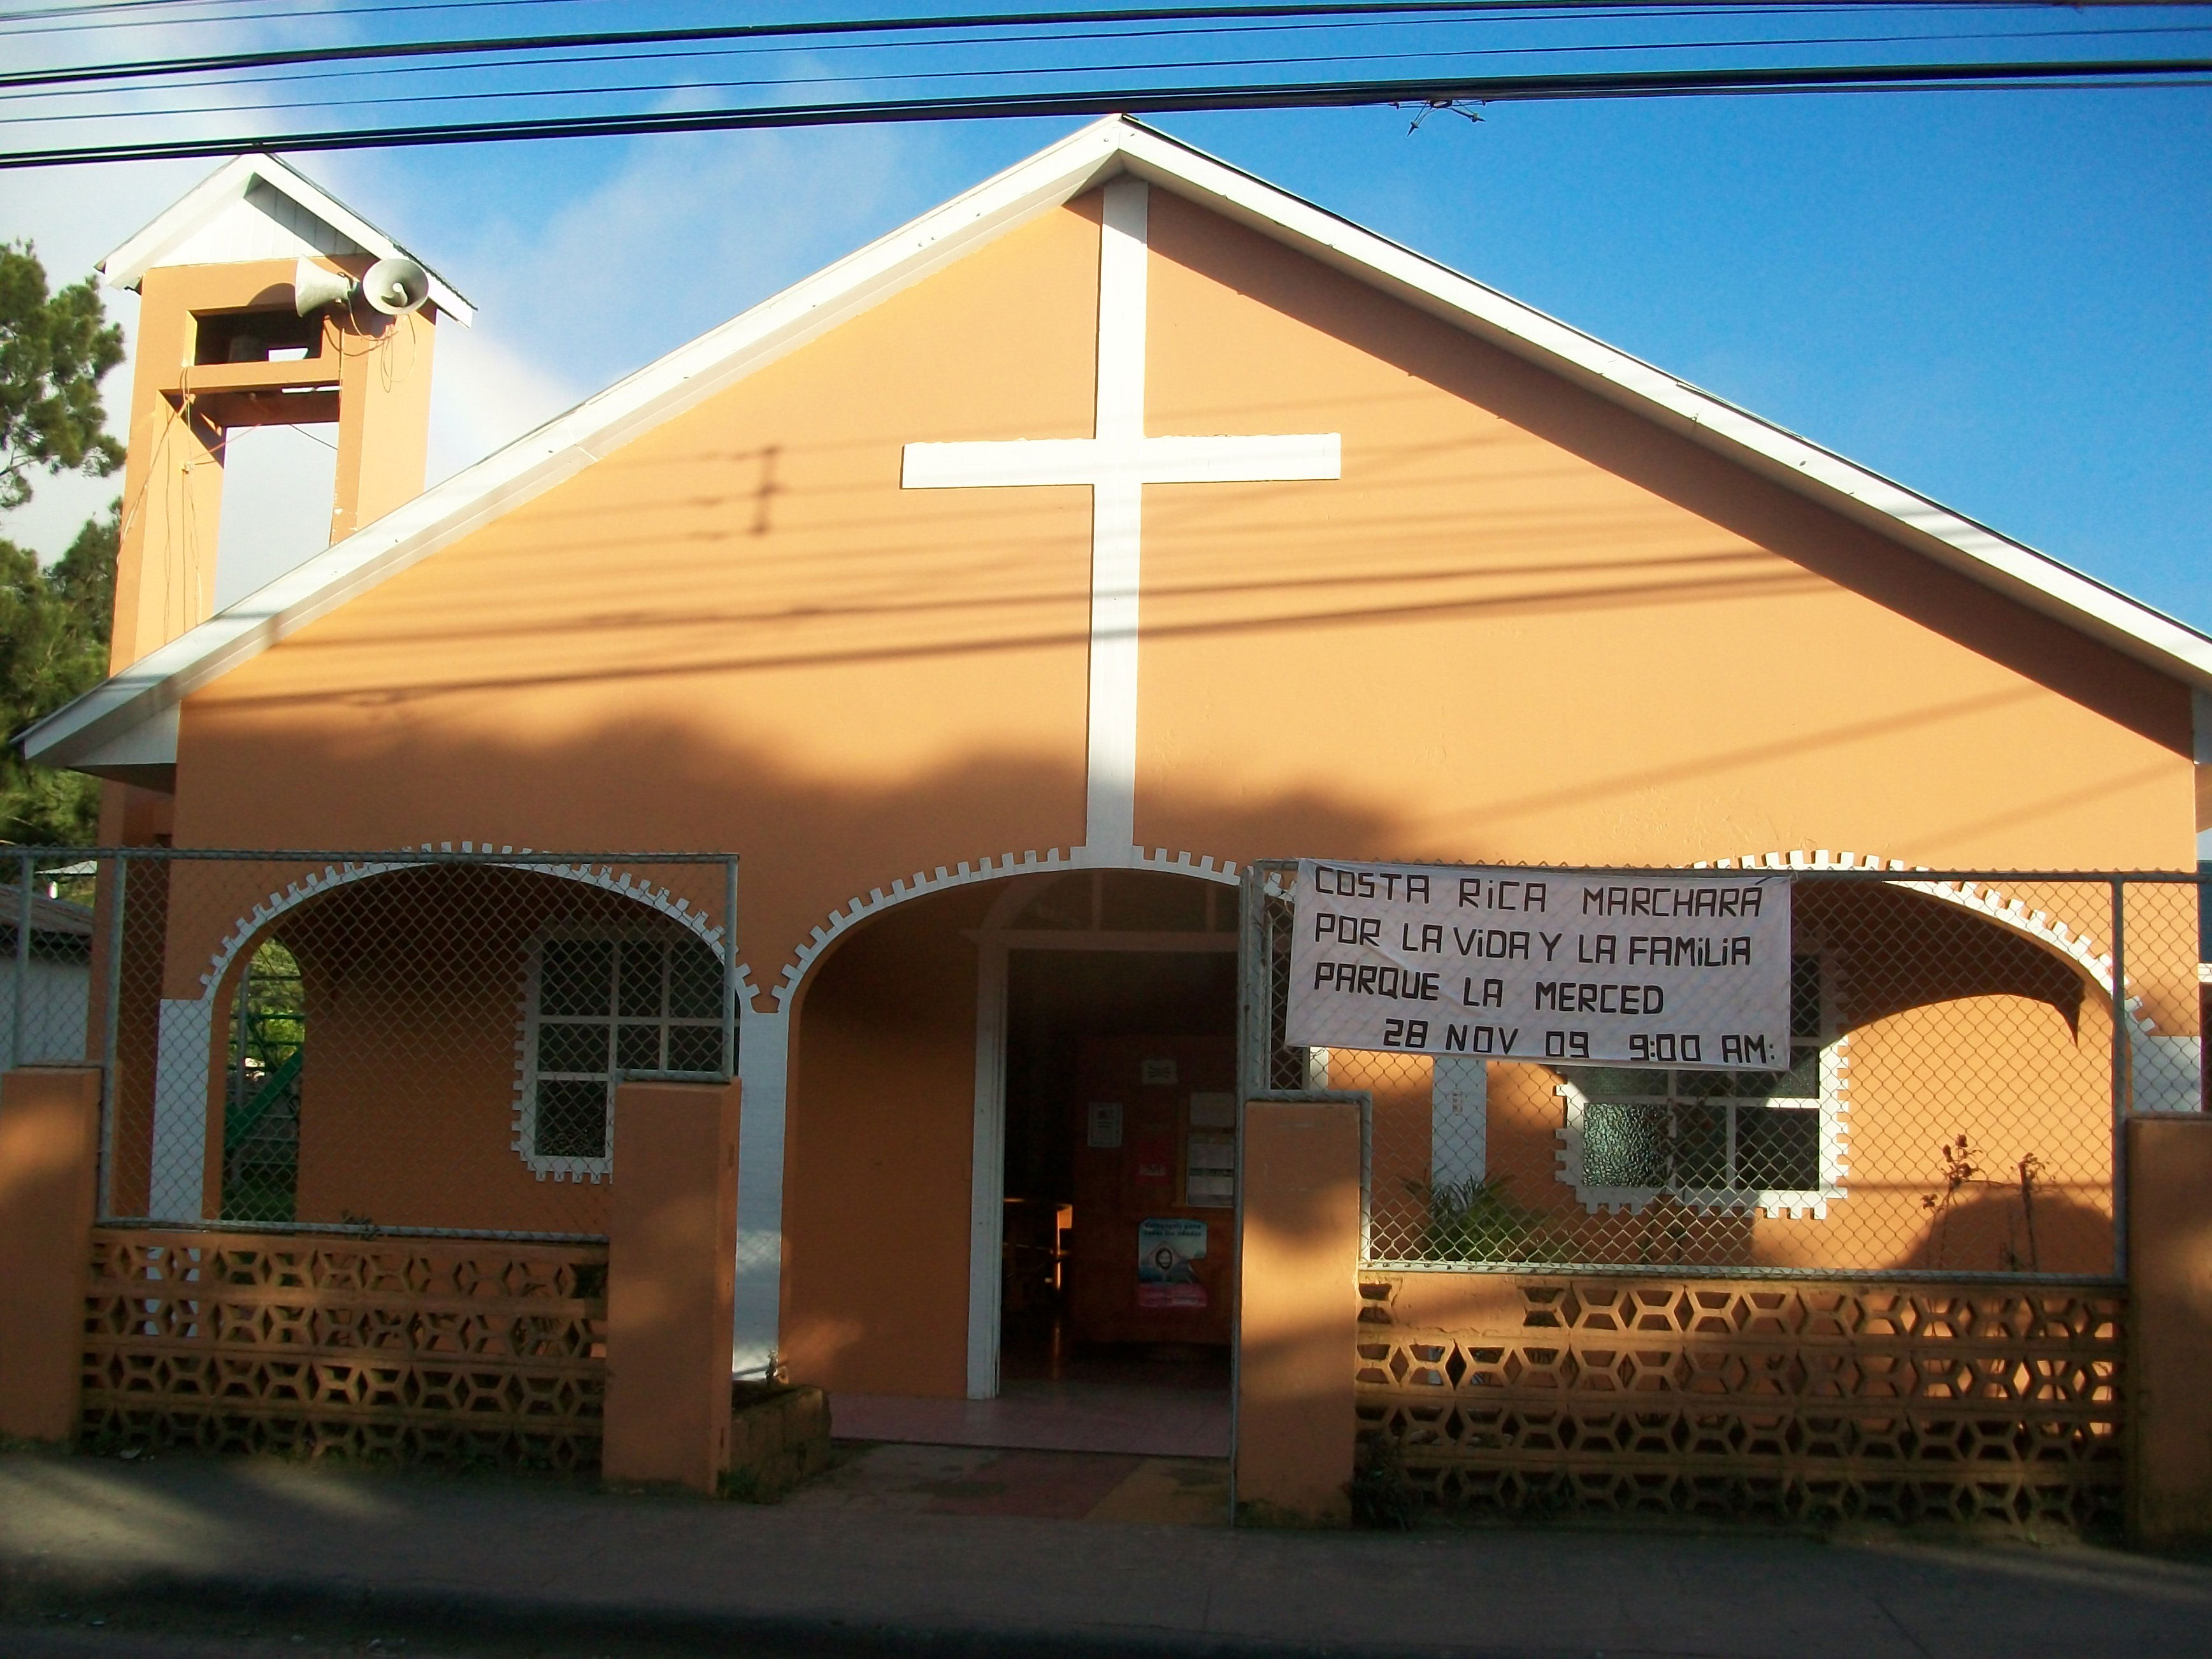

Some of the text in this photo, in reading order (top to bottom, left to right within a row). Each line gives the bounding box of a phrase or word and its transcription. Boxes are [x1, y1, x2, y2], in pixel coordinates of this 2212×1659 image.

[1314, 866, 1430, 904] COSTA
[1314, 912, 1381, 947] POR
[1402, 923, 1443, 954] LA
[1539, 931, 1563, 961] Y
[1578, 934, 1617, 964] LA
[1314, 962, 1663, 1015] PARQUE LA MERCED
[1383, 1018, 1429, 1049] 28
[1445, 1023, 1519, 1055] NOV
[1546, 1031, 1590, 1059] 09
[1629, 1033, 1702, 1062] 9:00
